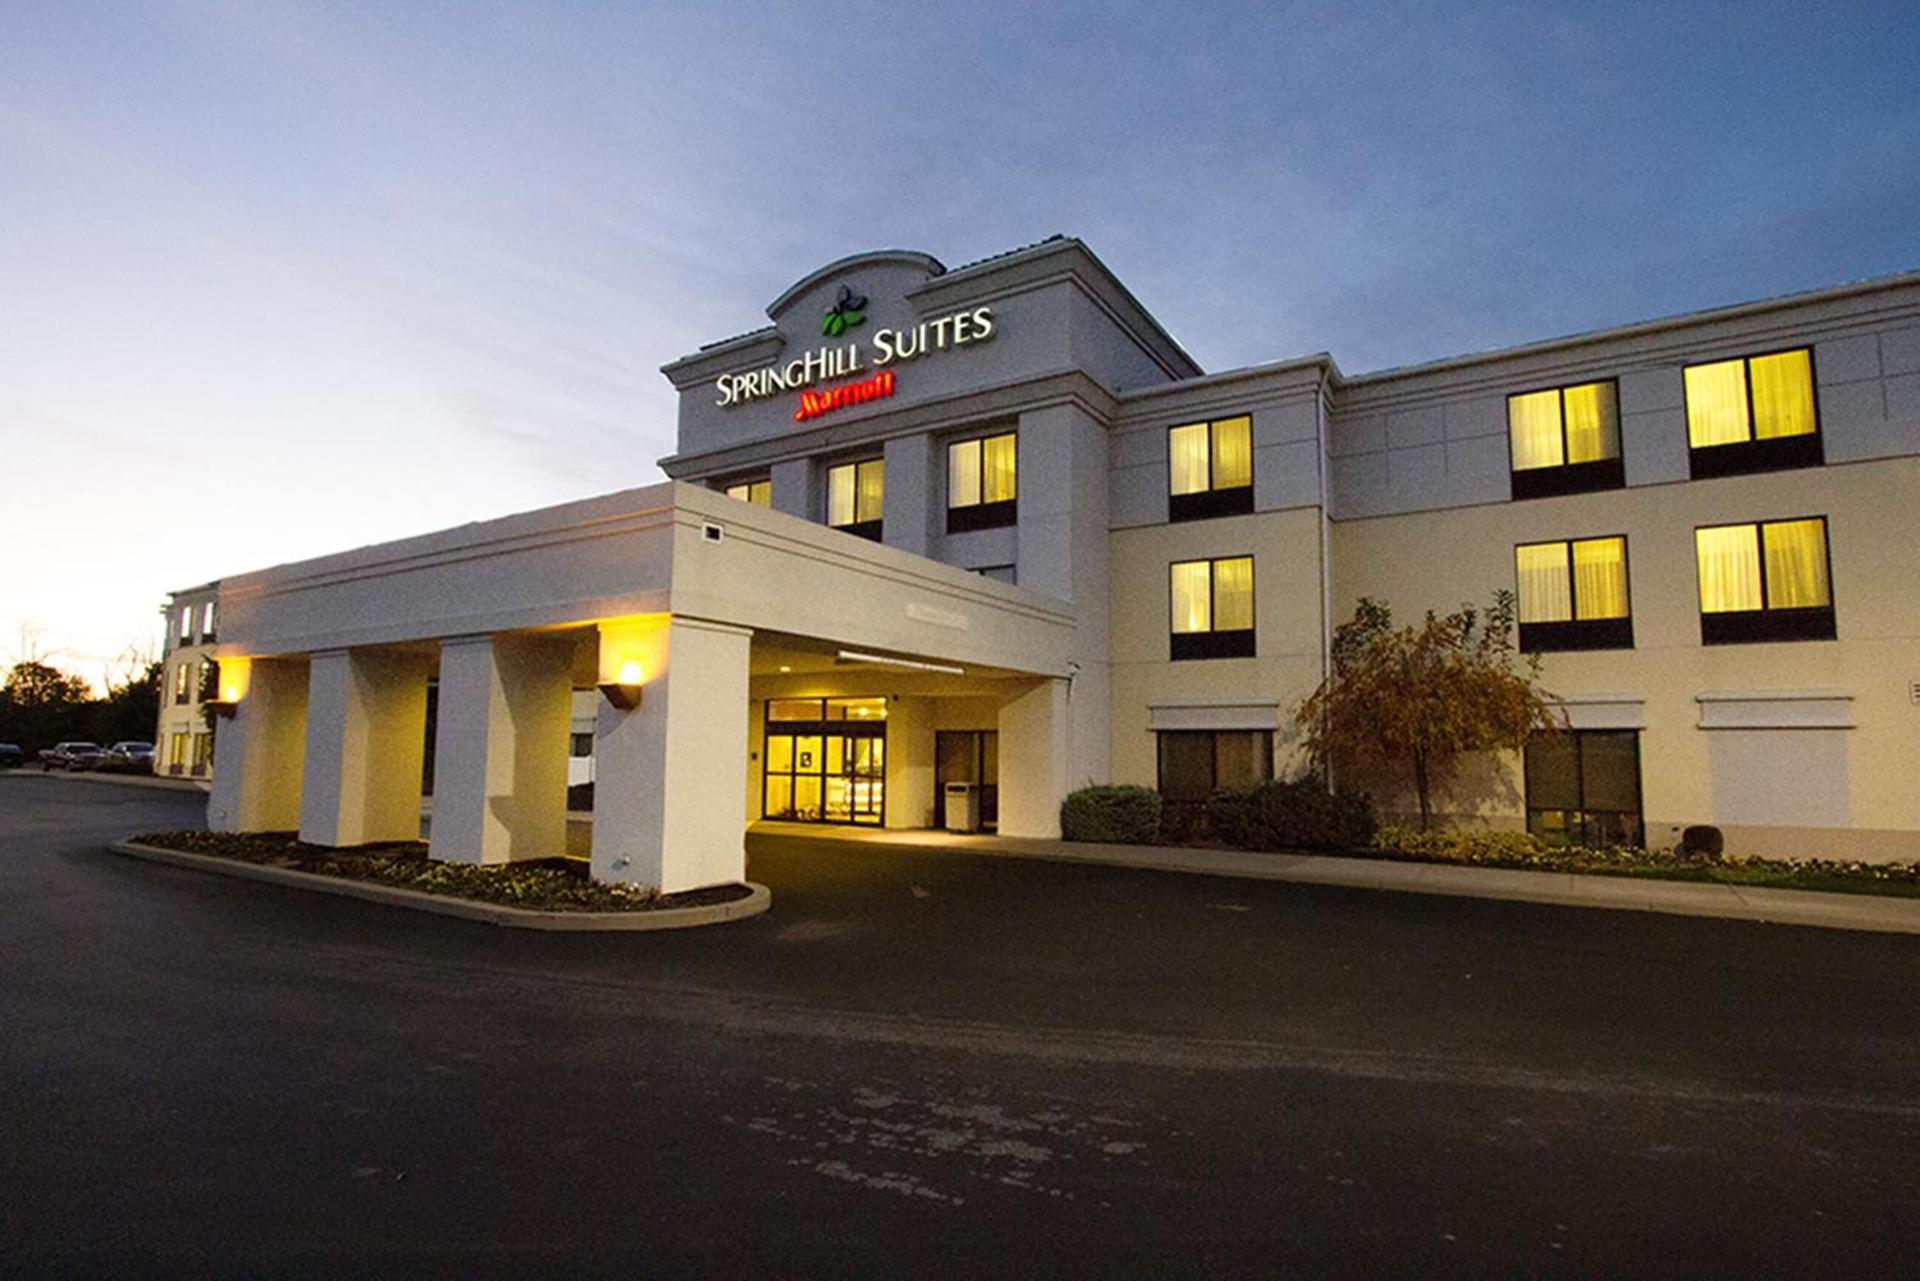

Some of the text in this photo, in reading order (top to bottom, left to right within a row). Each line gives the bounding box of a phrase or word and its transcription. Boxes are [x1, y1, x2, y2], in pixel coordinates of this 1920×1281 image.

[715, 307, 993, 408] SPRINGHILL SUITES
[795, 369, 895, 421] Marriott
